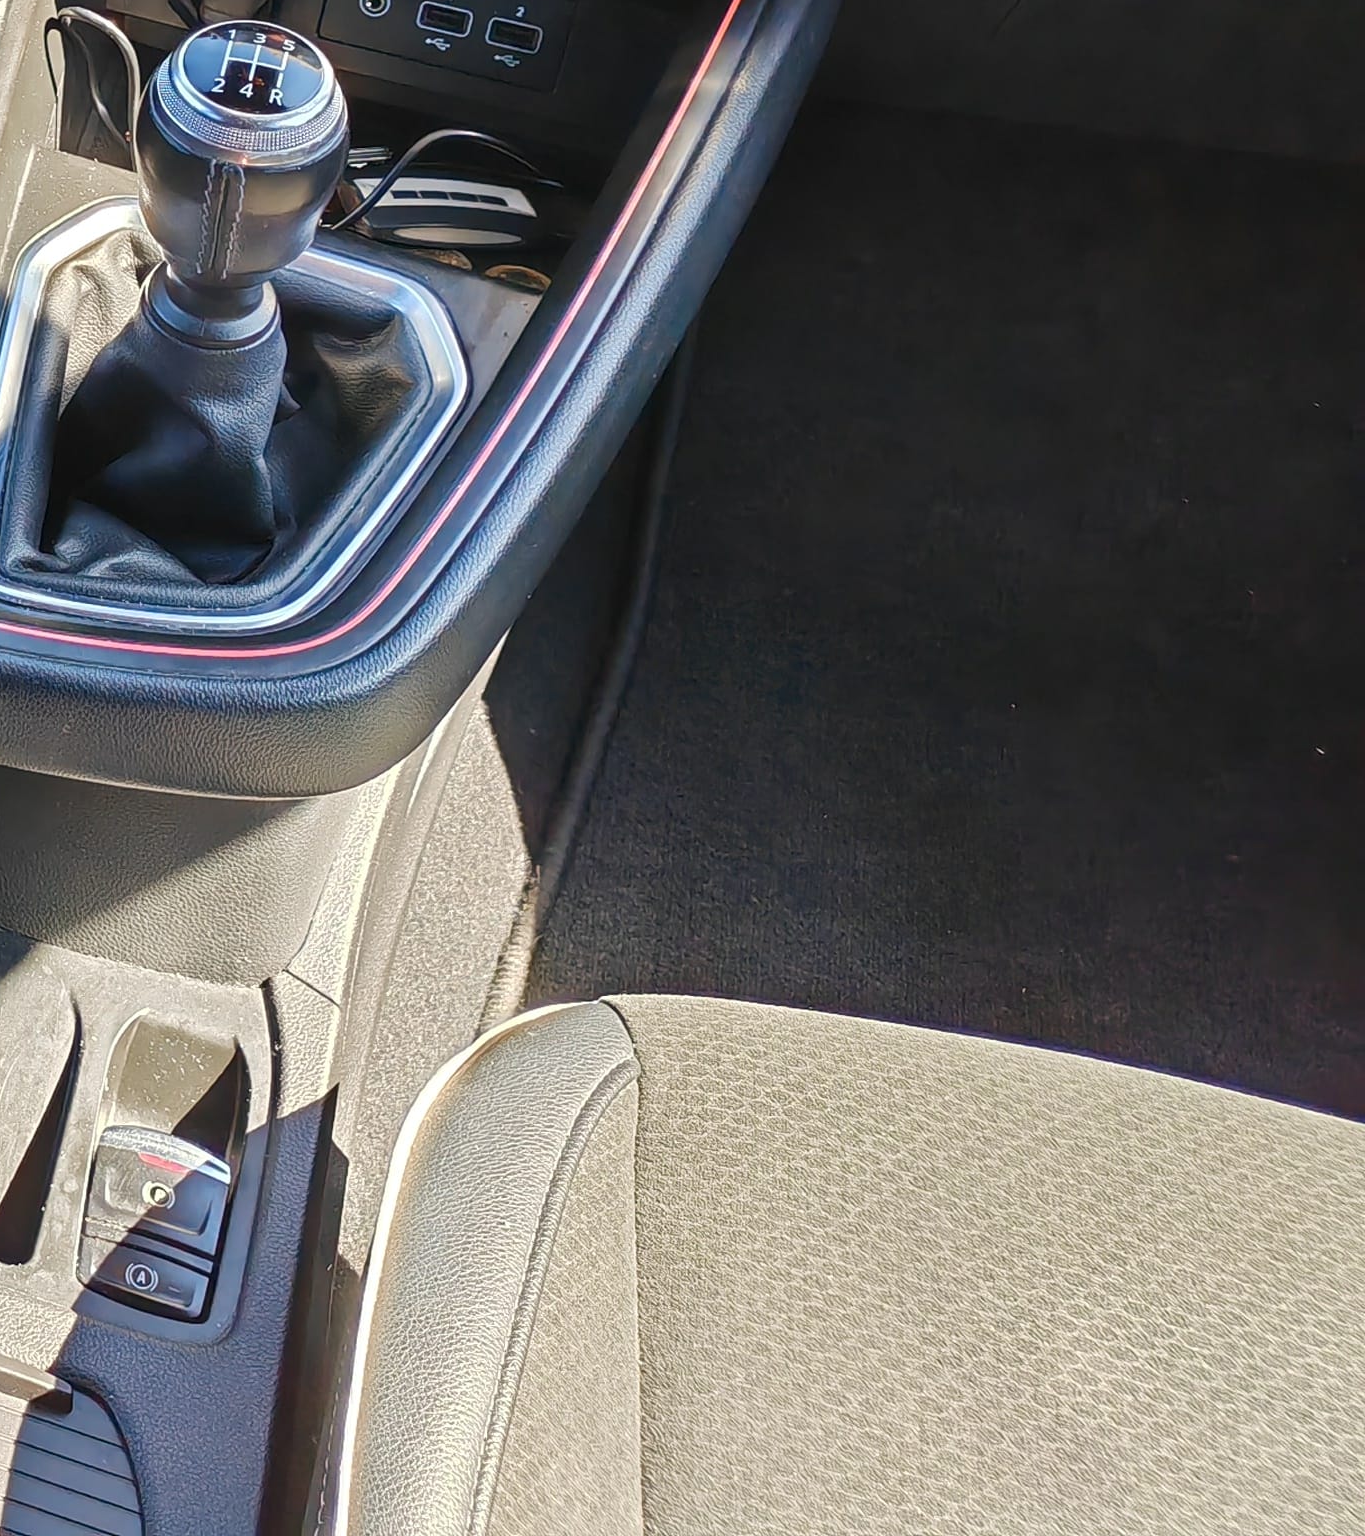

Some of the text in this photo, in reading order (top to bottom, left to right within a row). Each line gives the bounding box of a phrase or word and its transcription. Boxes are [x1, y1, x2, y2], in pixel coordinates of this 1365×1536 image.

[515, 6, 525, 17] 2
[228, 29, 296, 52] 1 3 5
[210, 78, 284, 106] 2 4 R
